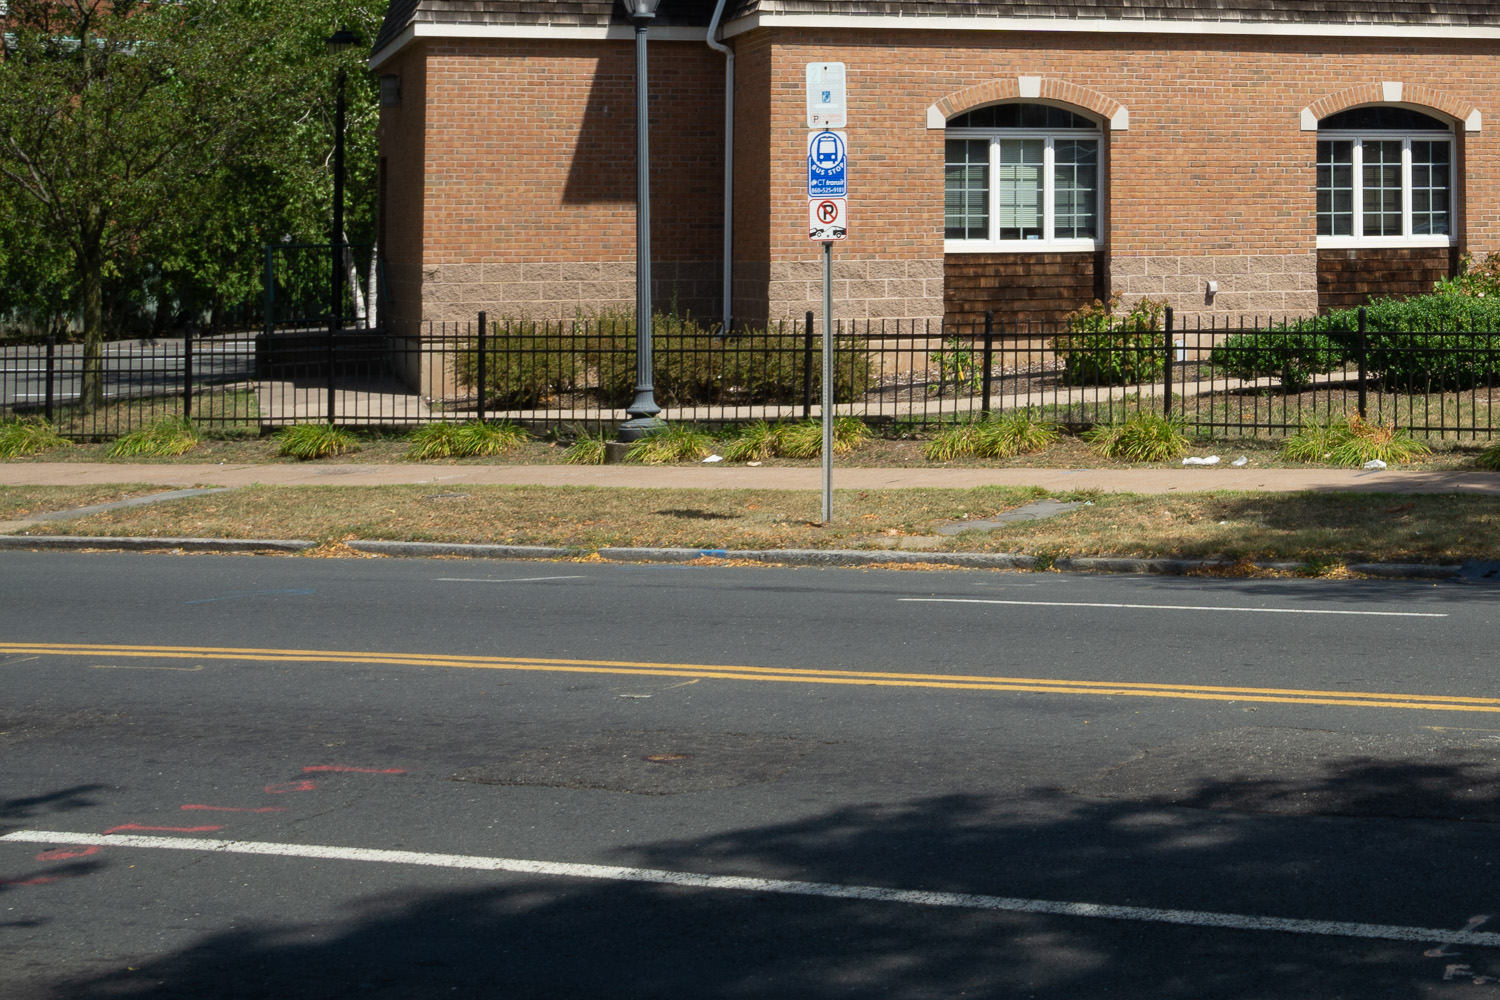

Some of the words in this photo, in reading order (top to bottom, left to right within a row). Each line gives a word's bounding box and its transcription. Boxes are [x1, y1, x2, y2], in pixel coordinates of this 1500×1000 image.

[811, 164, 825, 176] BUS
[828, 162, 844, 176] STOP
[822, 204, 834, 220] P
